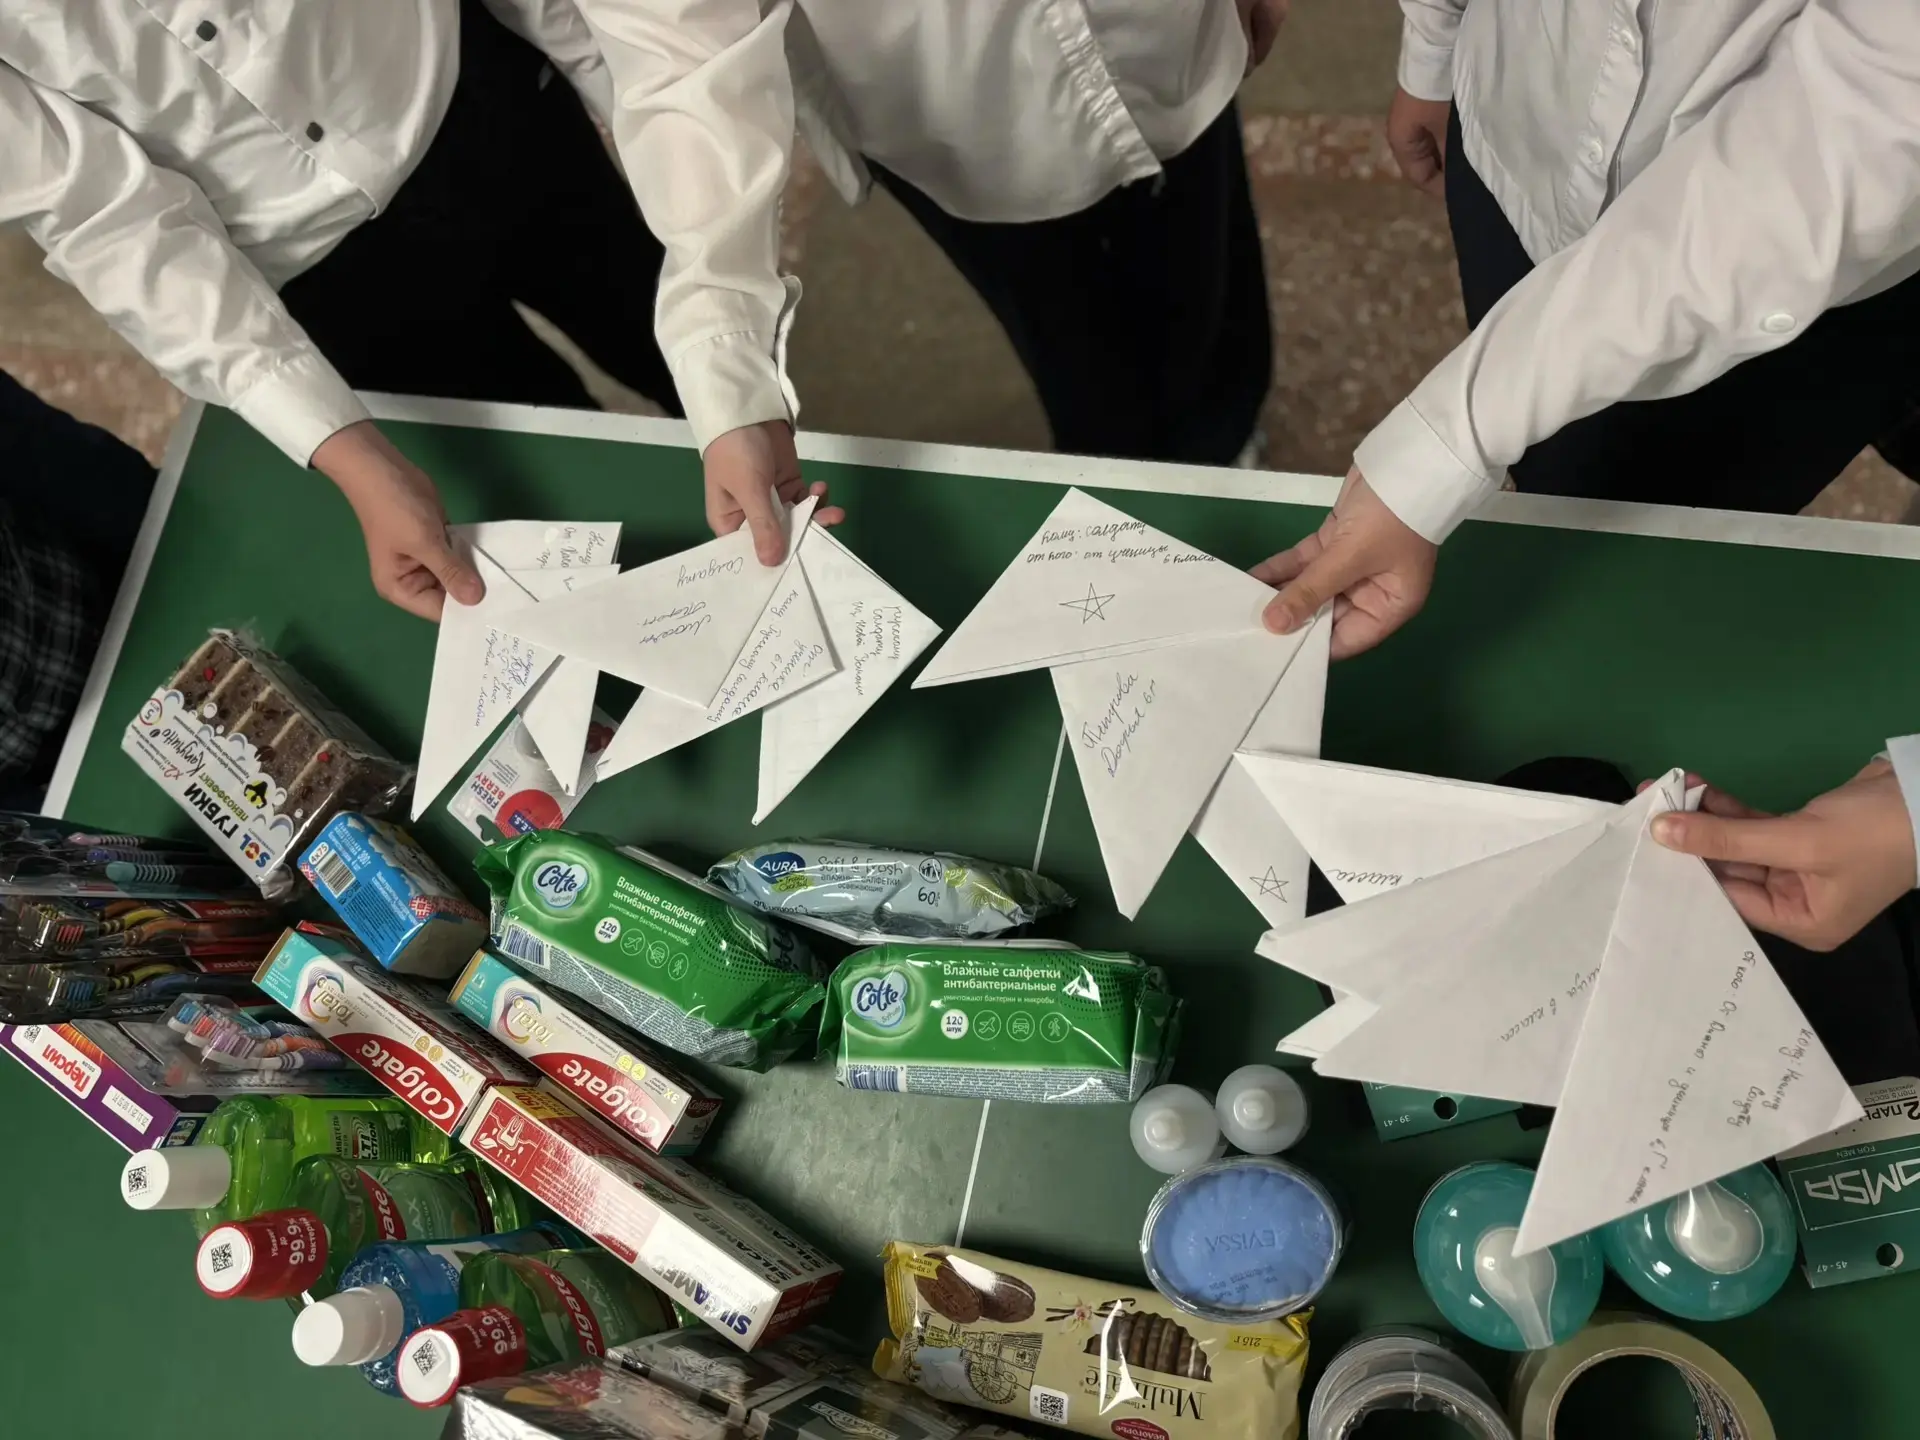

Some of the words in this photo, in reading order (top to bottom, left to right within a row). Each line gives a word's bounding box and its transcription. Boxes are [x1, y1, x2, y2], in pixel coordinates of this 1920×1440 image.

[145, 708, 155, 720] 5
[161, 729, 206, 777] Капучино
[198, 772, 249, 822] ПЕНОЭФФЕКТ
[468, 782, 500, 813] FRESH
[473, 771, 506, 802] BERRY
[184, 782, 239, 839] ГУБКИ
[240, 834, 271, 868] SOL
[760, 860, 800, 872] AURA
[818, 856, 845, 872] Soft
[537, 864, 577, 894] Cotte
[1323, 867, 1404, 887] класса
[616, 876, 660, 905] Влажные
[660, 896, 706, 928] салфетки
[918, 886, 936, 905] 60
[600, 920, 618, 934] 120
[612, 889, 697, 937] антибактериальные
[597, 929, 613, 940] штук
[943, 964, 999, 978] Влажные
[1002, 967, 1061, 981] салфетки
[943, 979, 1057, 993] антибактериальные
[313, 991, 355, 1028] Total
[856, 979, 899, 1012] Cotte
[984, 995, 1016, 1004] бактерии
[511, 1011, 555, 1048] Total
[945, 1016, 964, 1027] 120
[945, 1025, 963, 1034] штук
[42, 1044, 91, 1092] Персил
[361, 1039, 455, 1121] Colgate
[561, 1058, 661, 1139] Colgate
[1904, 1100, 1920, 1121] 2
[1836, 1148, 1858, 1158] MEN
[1859, 1145, 1876, 1155] FOR
[693, 1212, 791, 1282] SILCAMED
[550, 1272, 598, 1358] olgate
[1246, 1337, 1261, 1347] 215
